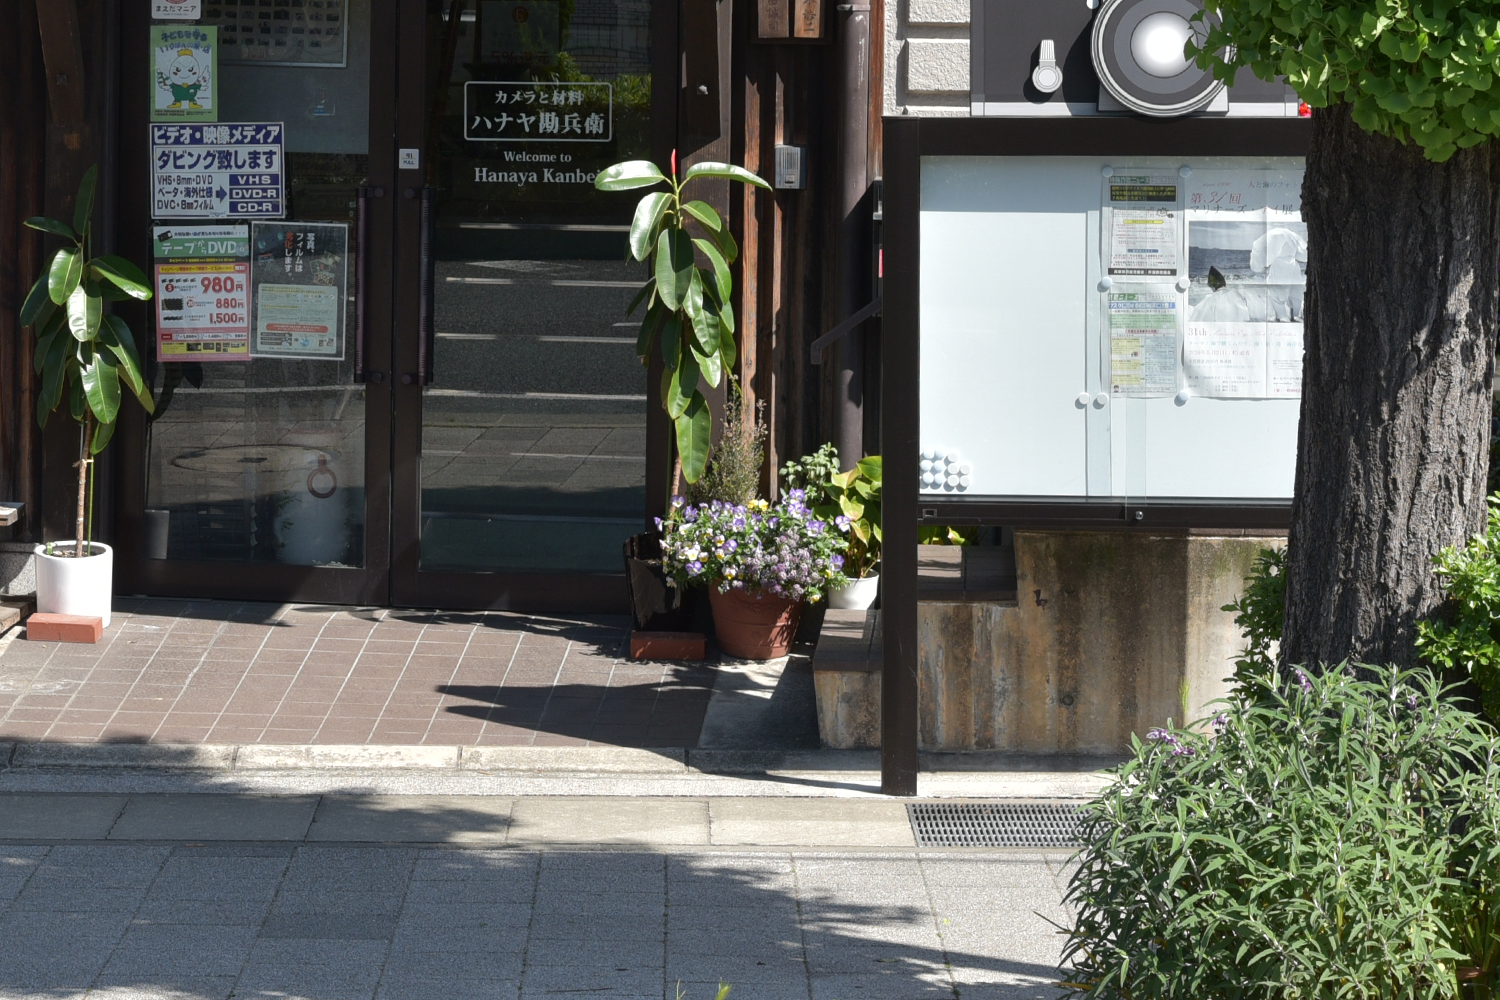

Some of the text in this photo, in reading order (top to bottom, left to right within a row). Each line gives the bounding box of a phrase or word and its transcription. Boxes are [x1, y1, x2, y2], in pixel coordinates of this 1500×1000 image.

[155, 5, 197, 13] まえだマニア
[160, 28, 208, 42] 子どもを守る
[494, 89, 584, 106] カメラと材料
[470, 111, 605, 135] ハナヤ勘兵衛
[153, 125, 280, 145] ビデオ・映像メディア
[157, 149, 277, 171] ダビング致します
[503, 150, 572, 163] Welcome to
[238, 175, 272, 185] VHS
[474, 166, 538, 187] Hanaya
[232, 189, 277, 199] DVD-R
[237, 202, 273, 212] CD-R
[161, 239, 237, 256] テープからDVD
[294, 232, 305, 272] フィルムは
